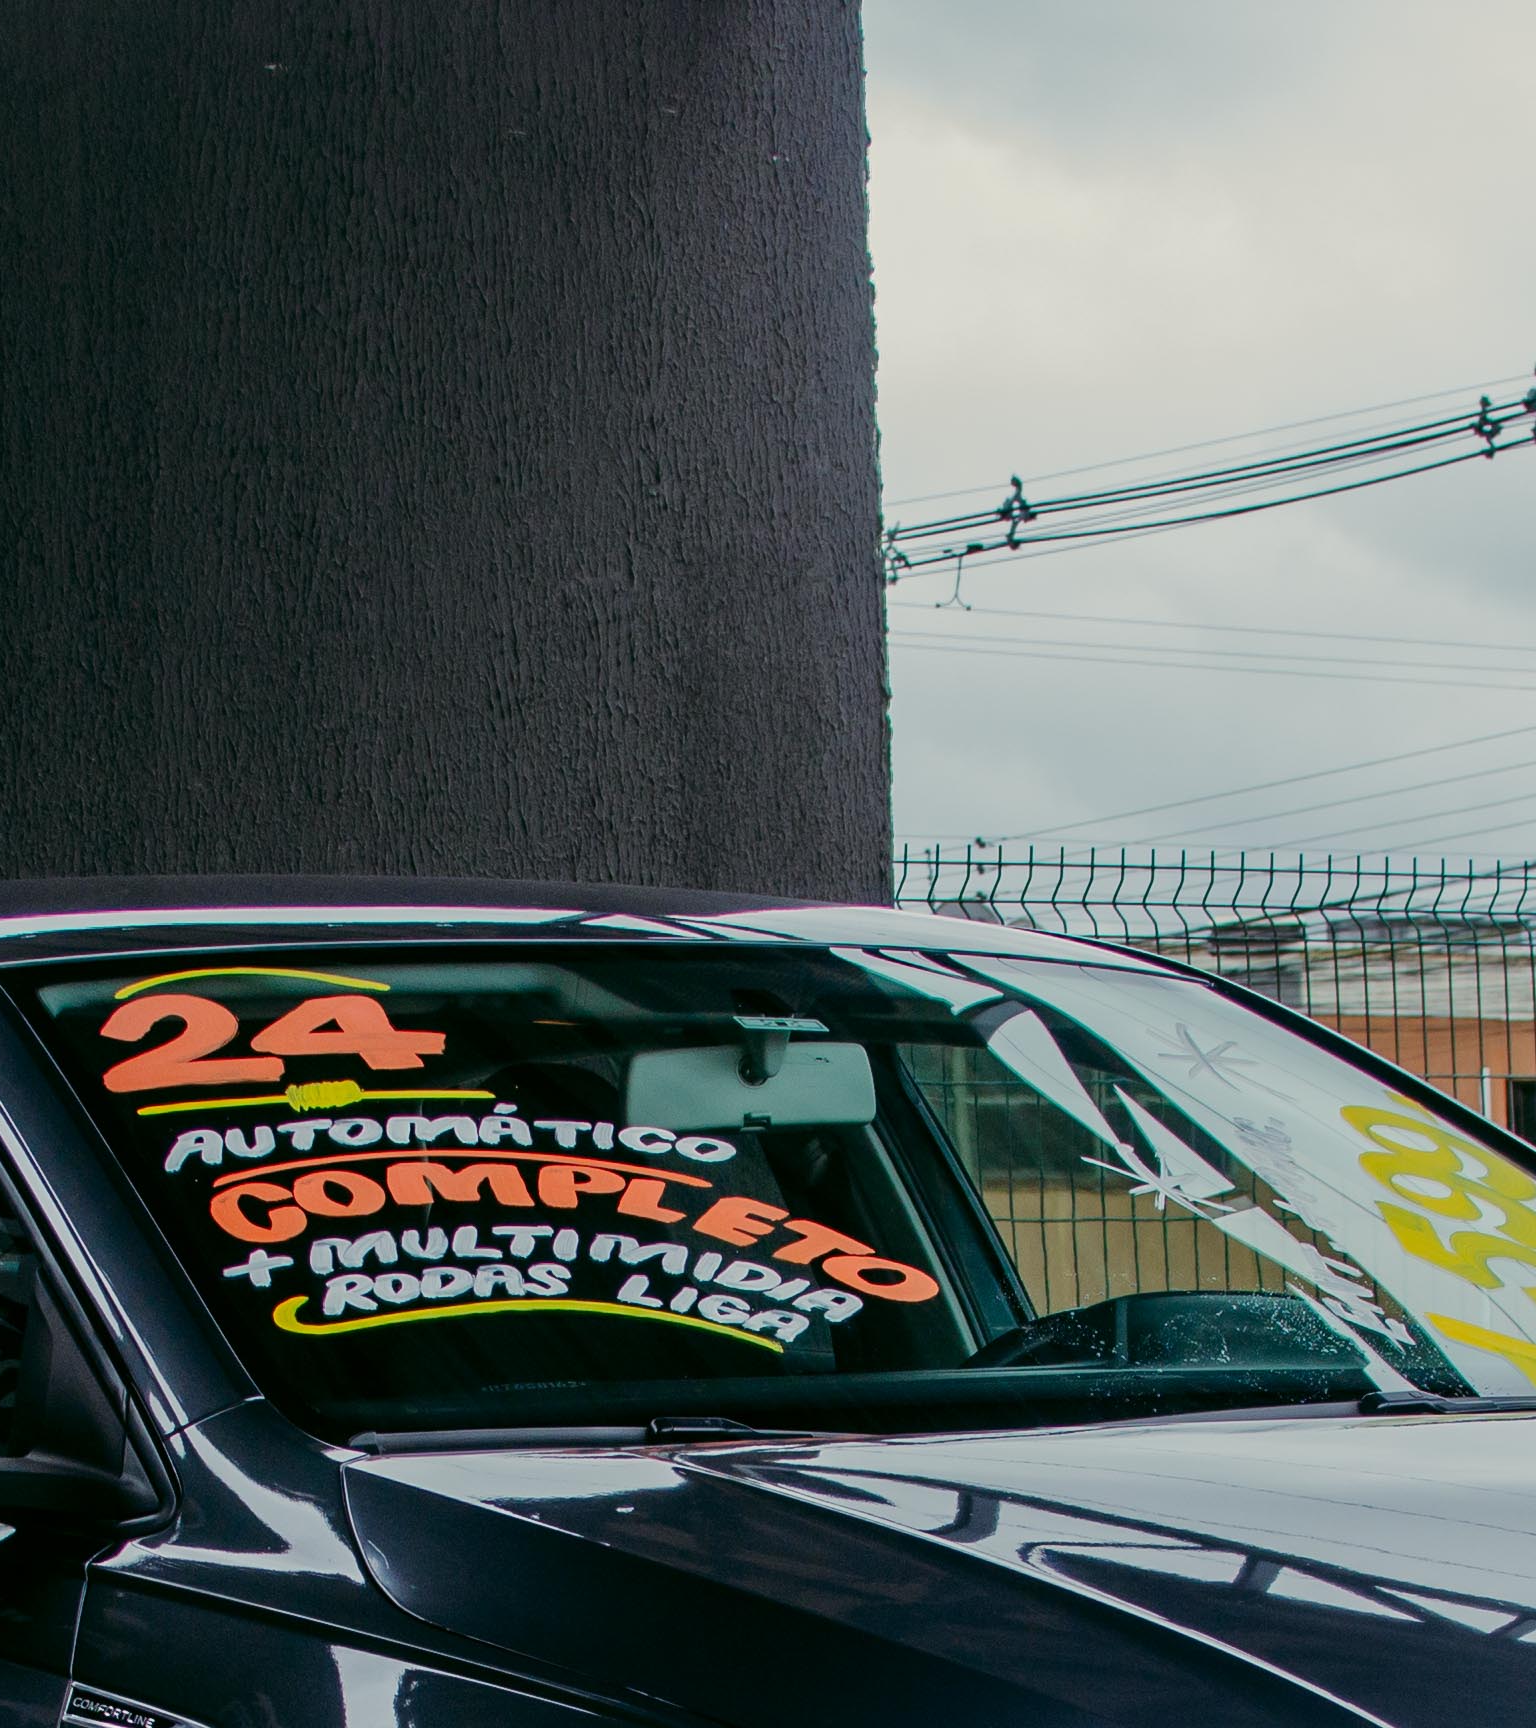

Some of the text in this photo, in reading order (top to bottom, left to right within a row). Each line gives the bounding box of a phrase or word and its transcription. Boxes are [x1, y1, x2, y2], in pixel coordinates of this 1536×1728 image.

[99, 993, 447, 1092] 24
[164, 1103, 738, 1172] AUTOMÁTICO
[209, 1160, 940, 1303] COMPLETO
[223, 1225, 864, 1323] + MULTIMIDIA
[322, 1263, 811, 1344] RODAS LIGA
